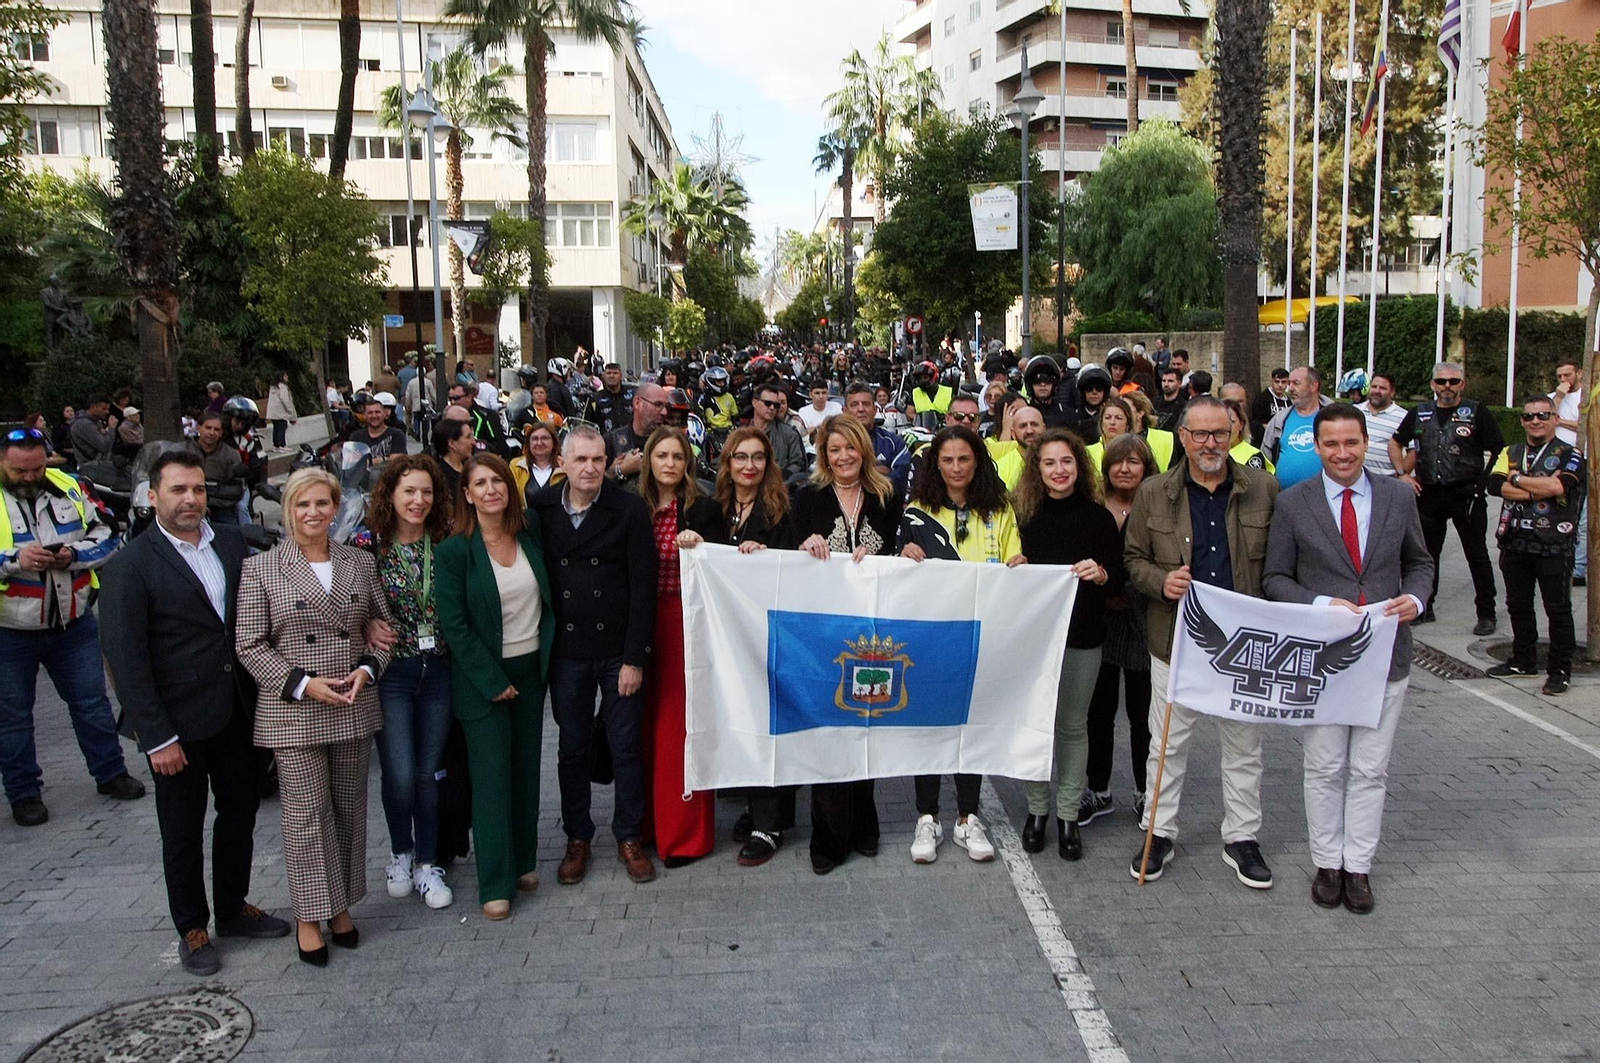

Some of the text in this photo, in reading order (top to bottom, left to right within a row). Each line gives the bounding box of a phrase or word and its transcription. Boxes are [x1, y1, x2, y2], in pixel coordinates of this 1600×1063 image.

[1209, 626, 1327, 706] 44
[1251, 641, 1264, 671] SUPER
[1299, 648, 1312, 677] HUGO
[1229, 698, 1316, 719] FOREVER
